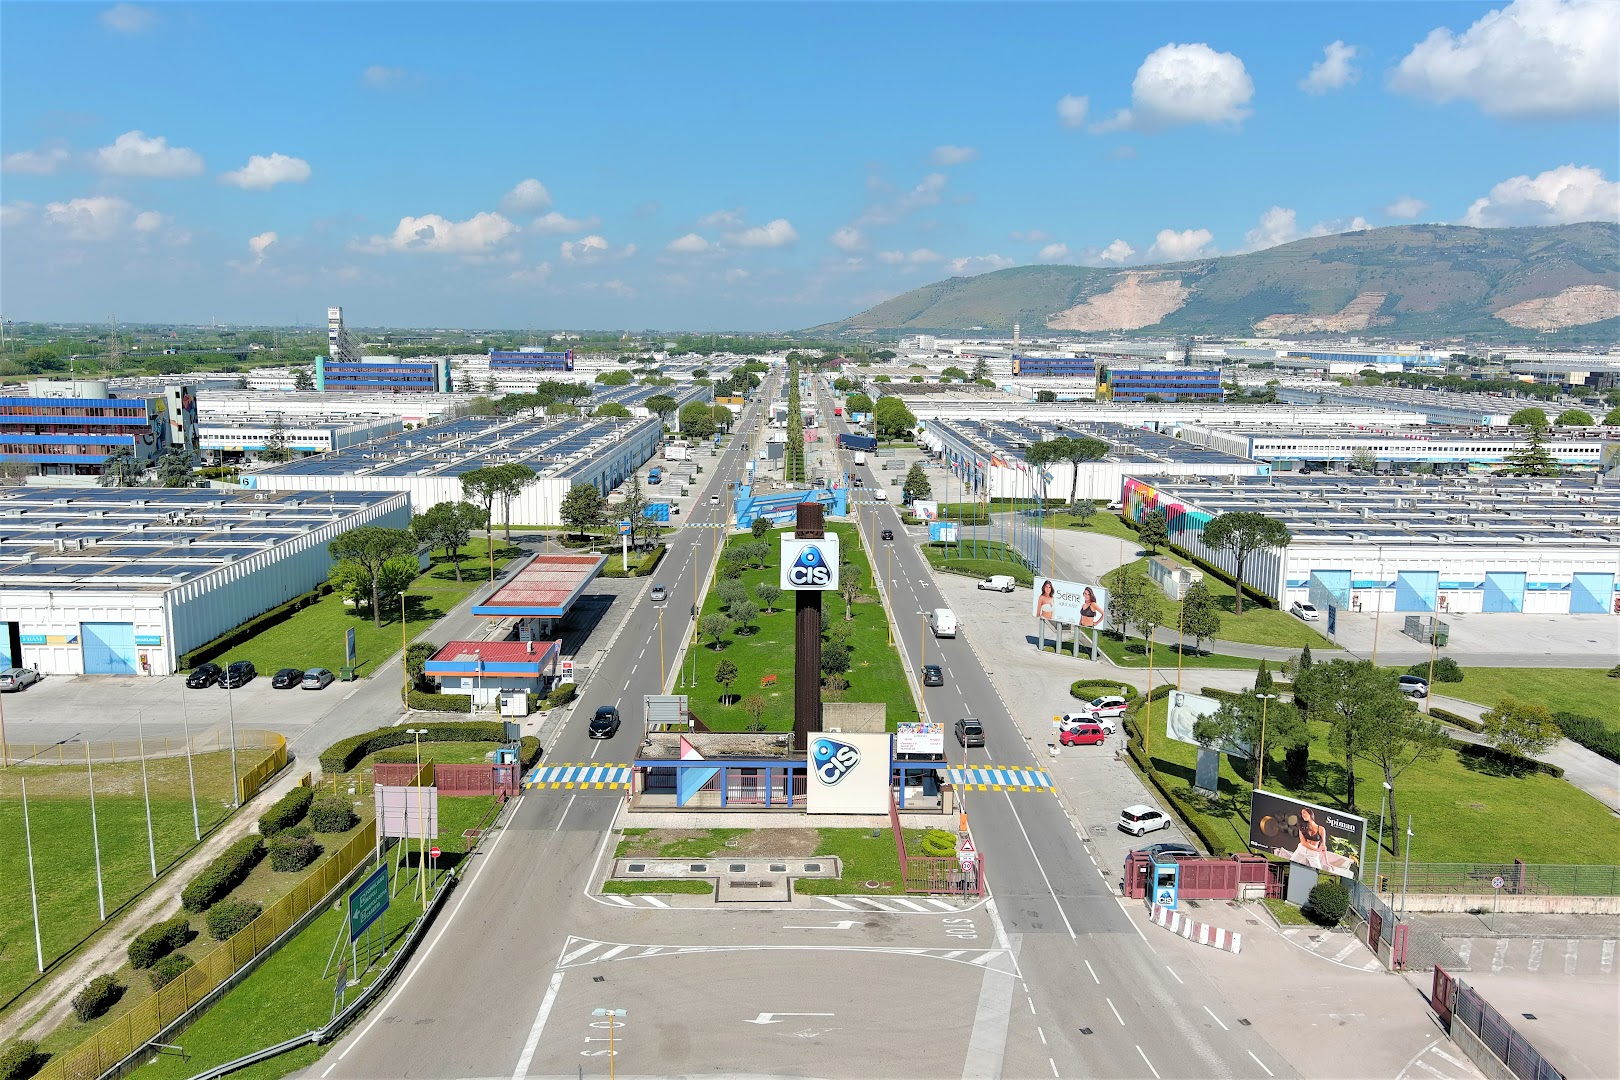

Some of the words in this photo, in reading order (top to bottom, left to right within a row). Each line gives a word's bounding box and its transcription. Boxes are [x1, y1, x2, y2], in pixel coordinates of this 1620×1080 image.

[242, 477, 250, 486] 6
[791, 566, 829, 585] CIS
[819, 746, 860, 784] CIS
[1326, 815, 1356, 832] Spiman
[1158, 897, 1173, 905] CIS
[942, 918, 979, 940] STOP
